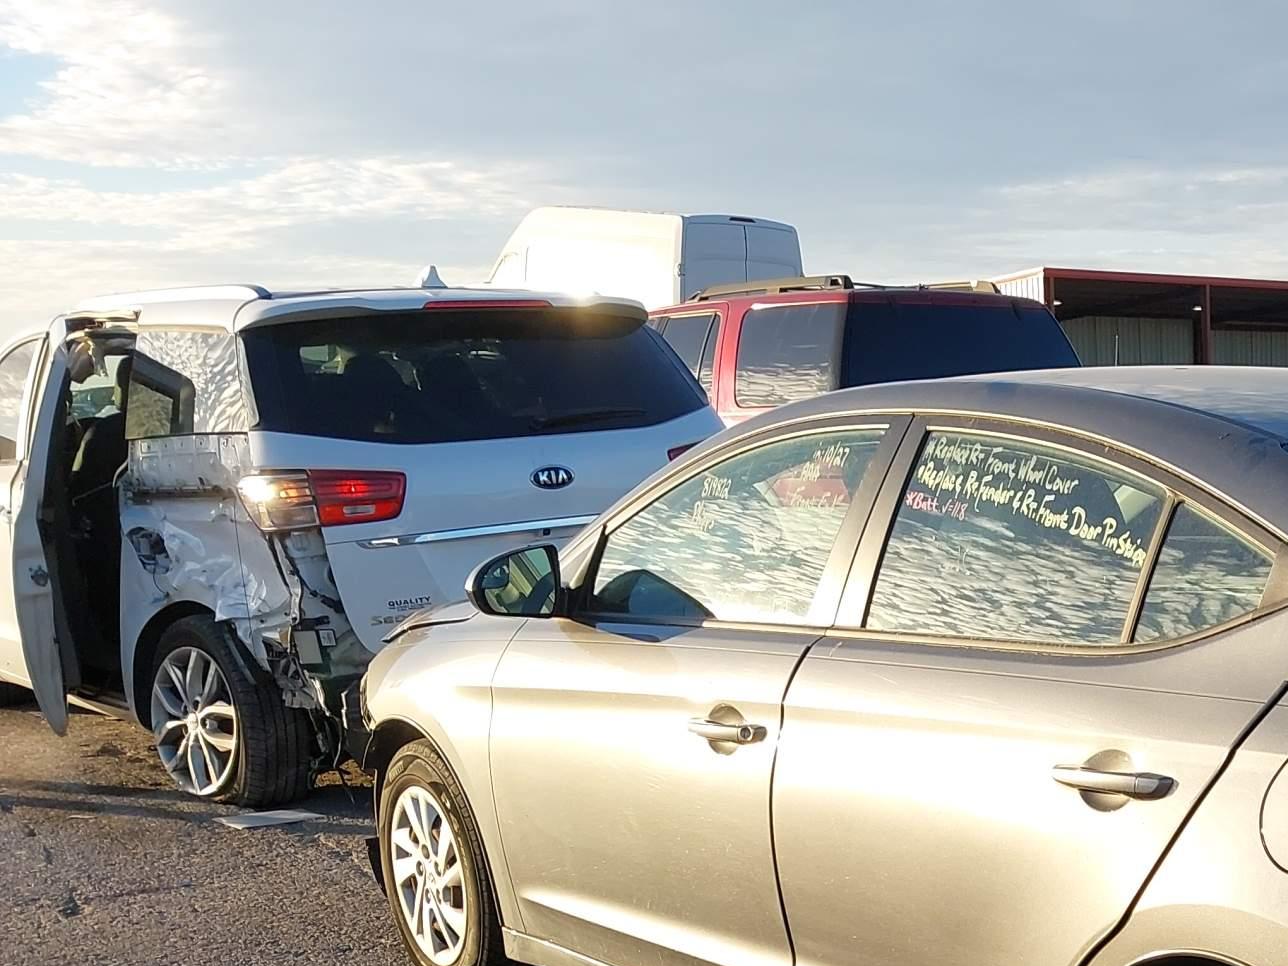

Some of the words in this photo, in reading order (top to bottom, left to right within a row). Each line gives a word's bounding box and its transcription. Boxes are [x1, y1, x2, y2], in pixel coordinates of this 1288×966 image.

[537, 469, 569, 485] KIA
[1045, 466, 1079, 494] Cover
[1069, 506, 1102, 539] Door
[388, 596, 431, 607] QUALITY
